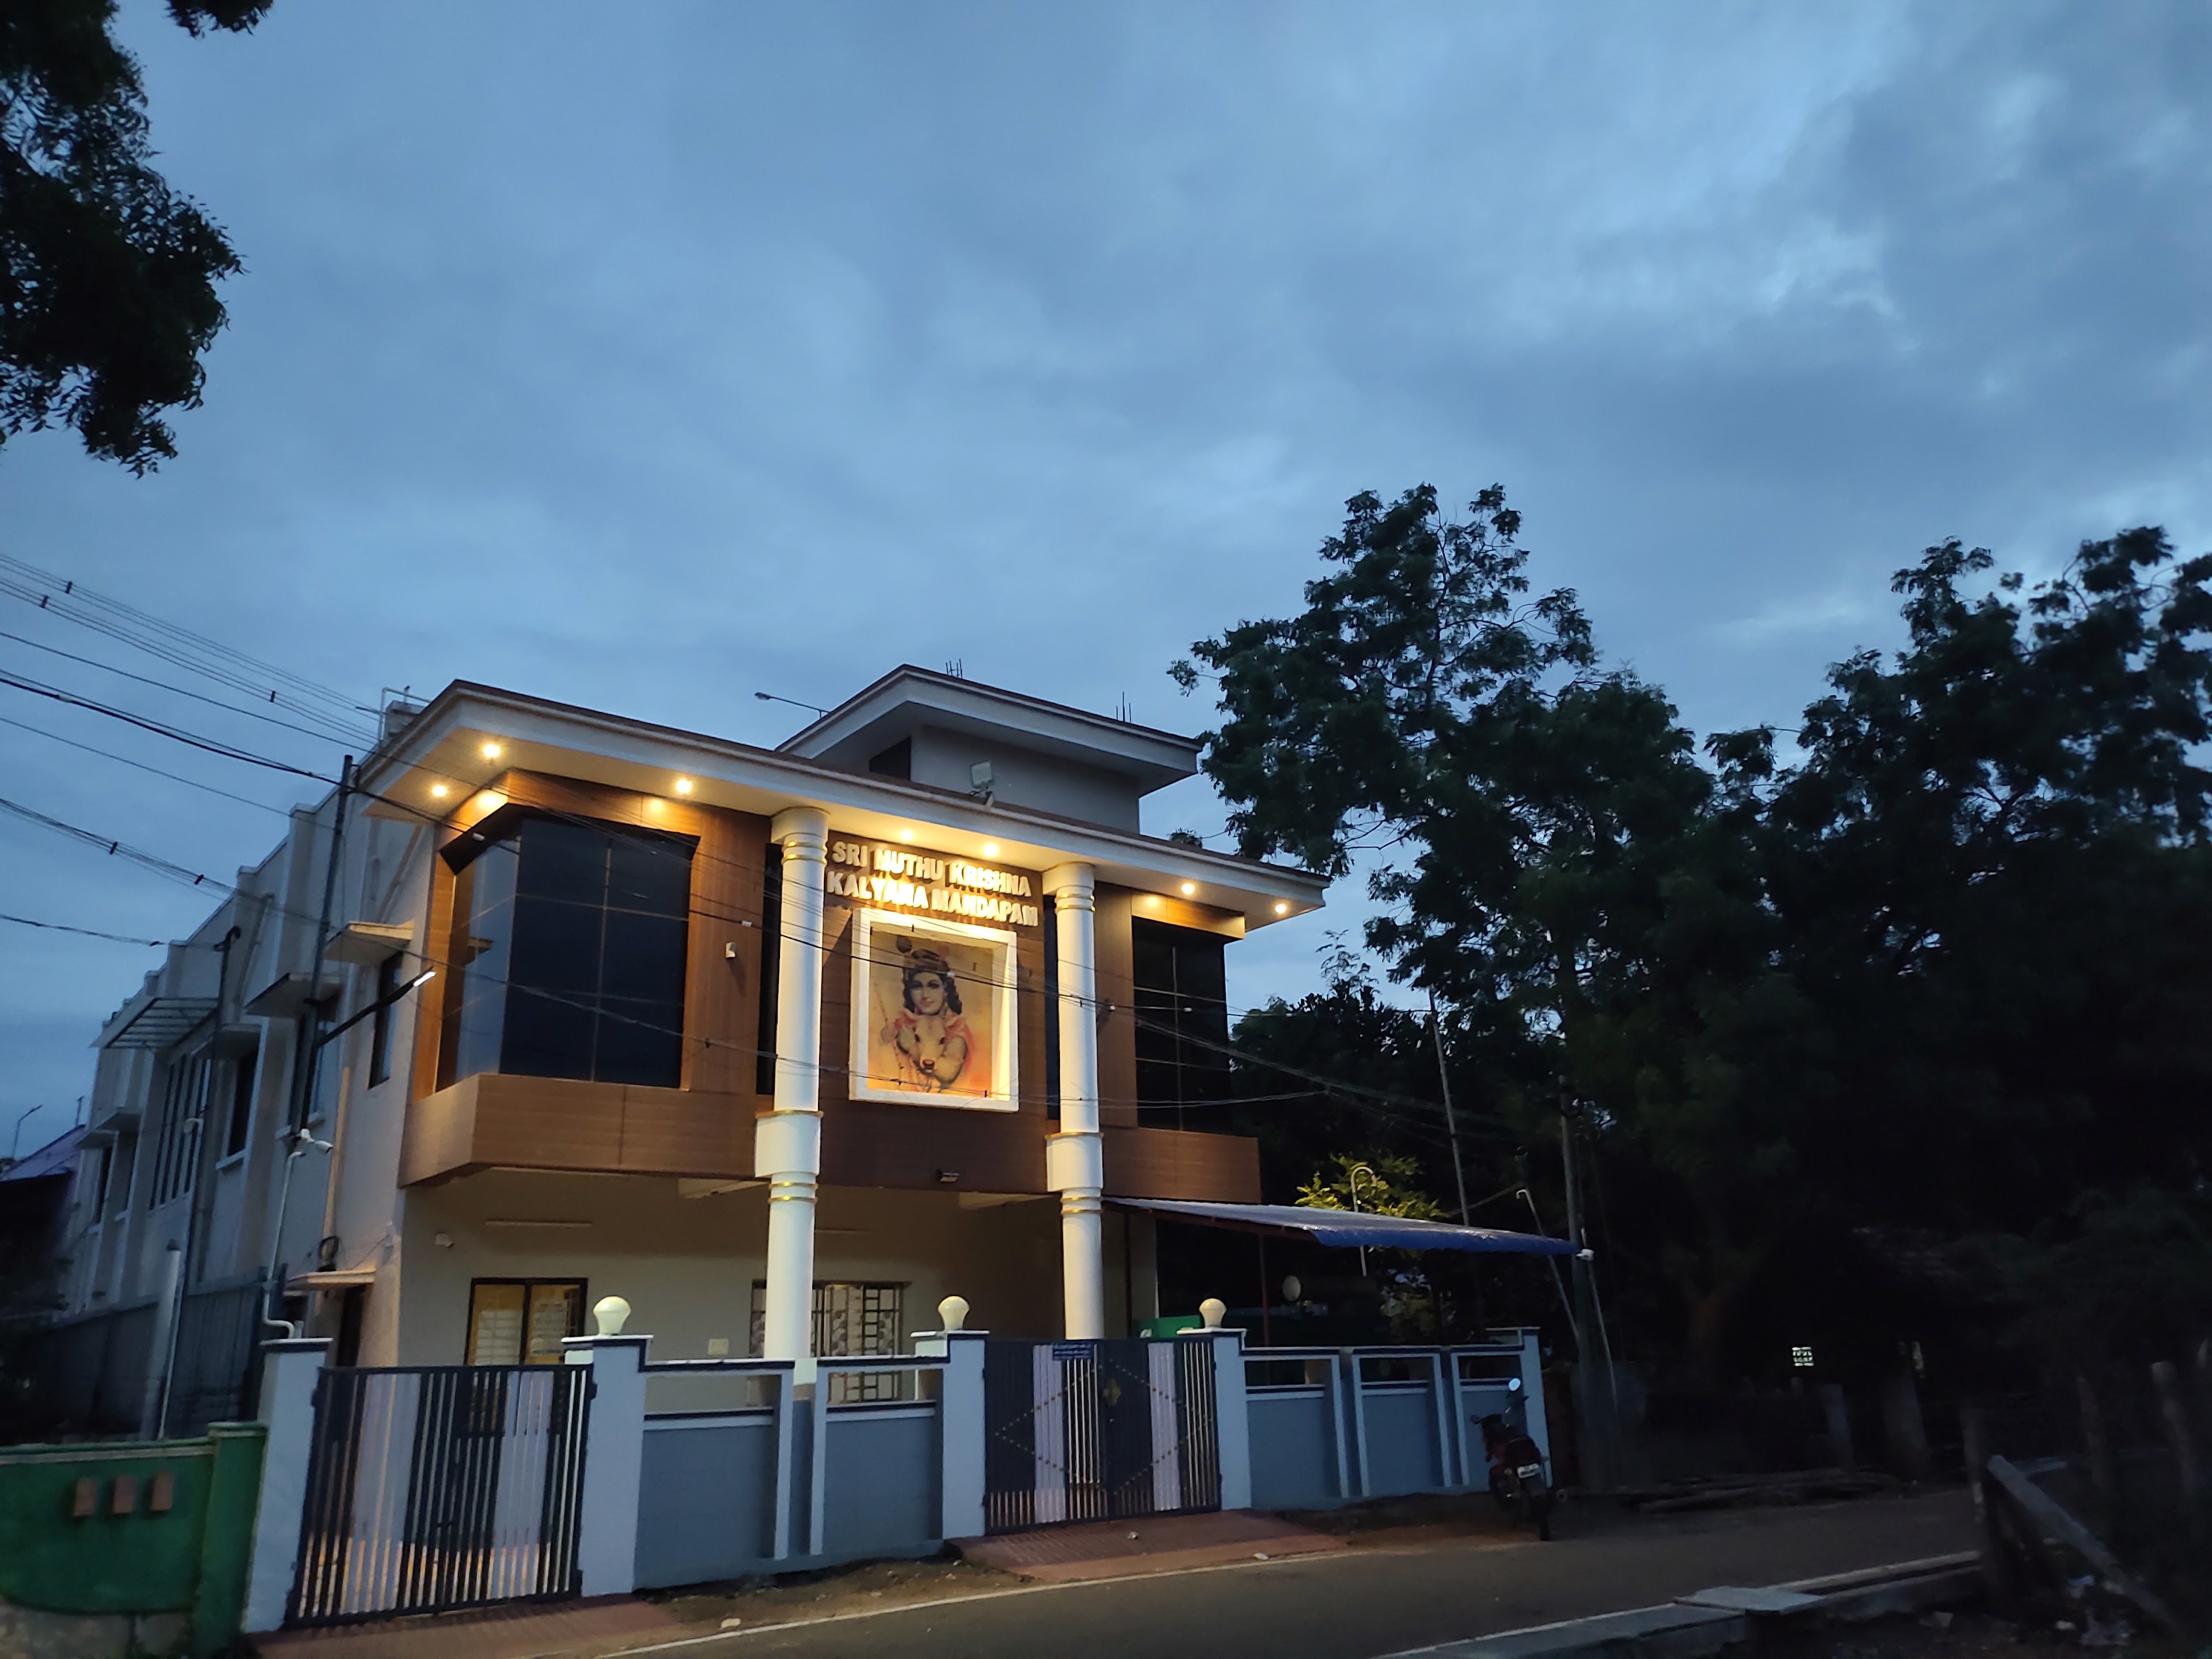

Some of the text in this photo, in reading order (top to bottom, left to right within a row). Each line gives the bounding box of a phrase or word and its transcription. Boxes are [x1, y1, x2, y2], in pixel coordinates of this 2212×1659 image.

[833, 842, 1031, 897] SRI MUTHU KRISHNA
[827, 871, 1039, 927] KALYANA MANDAPAM
